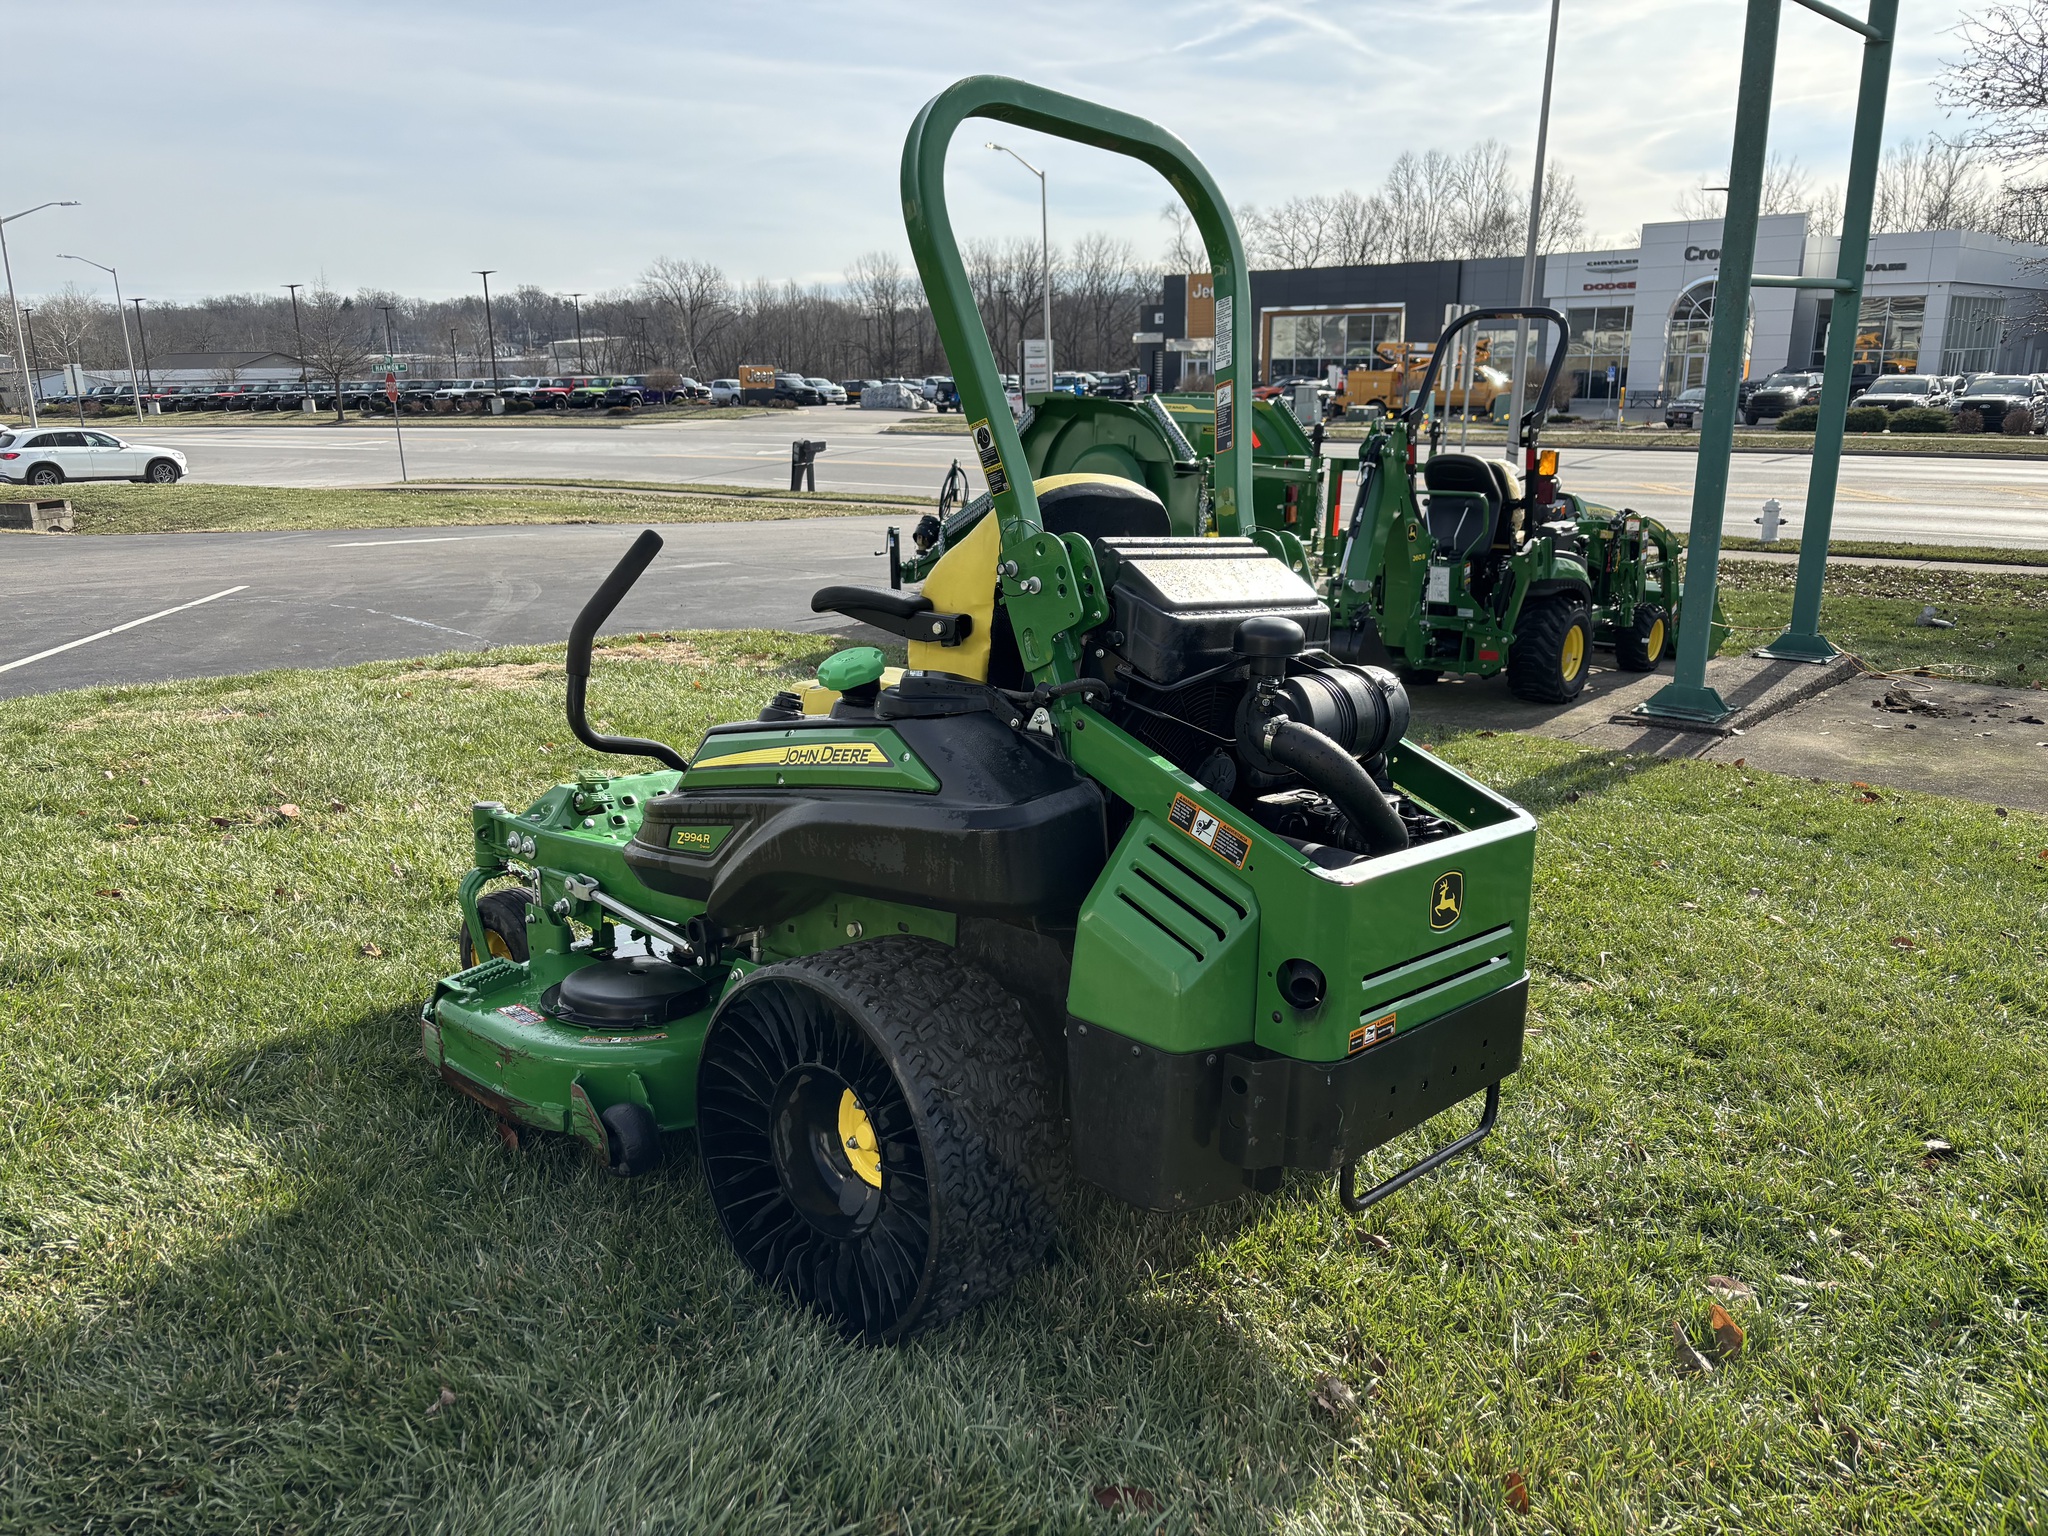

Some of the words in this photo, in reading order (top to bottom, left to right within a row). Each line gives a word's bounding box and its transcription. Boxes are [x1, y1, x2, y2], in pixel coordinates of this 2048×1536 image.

[1684, 246, 1721, 261] Cro
[1586, 259, 1639, 267] CHRYSLER
[1583, 281, 1637, 291] DODGE
[746, 368, 773, 384] Jeep
[780, 747, 820, 764] JOHN
[820, 746, 872, 763] DEERE
[677, 831, 710, 845] Z994R
